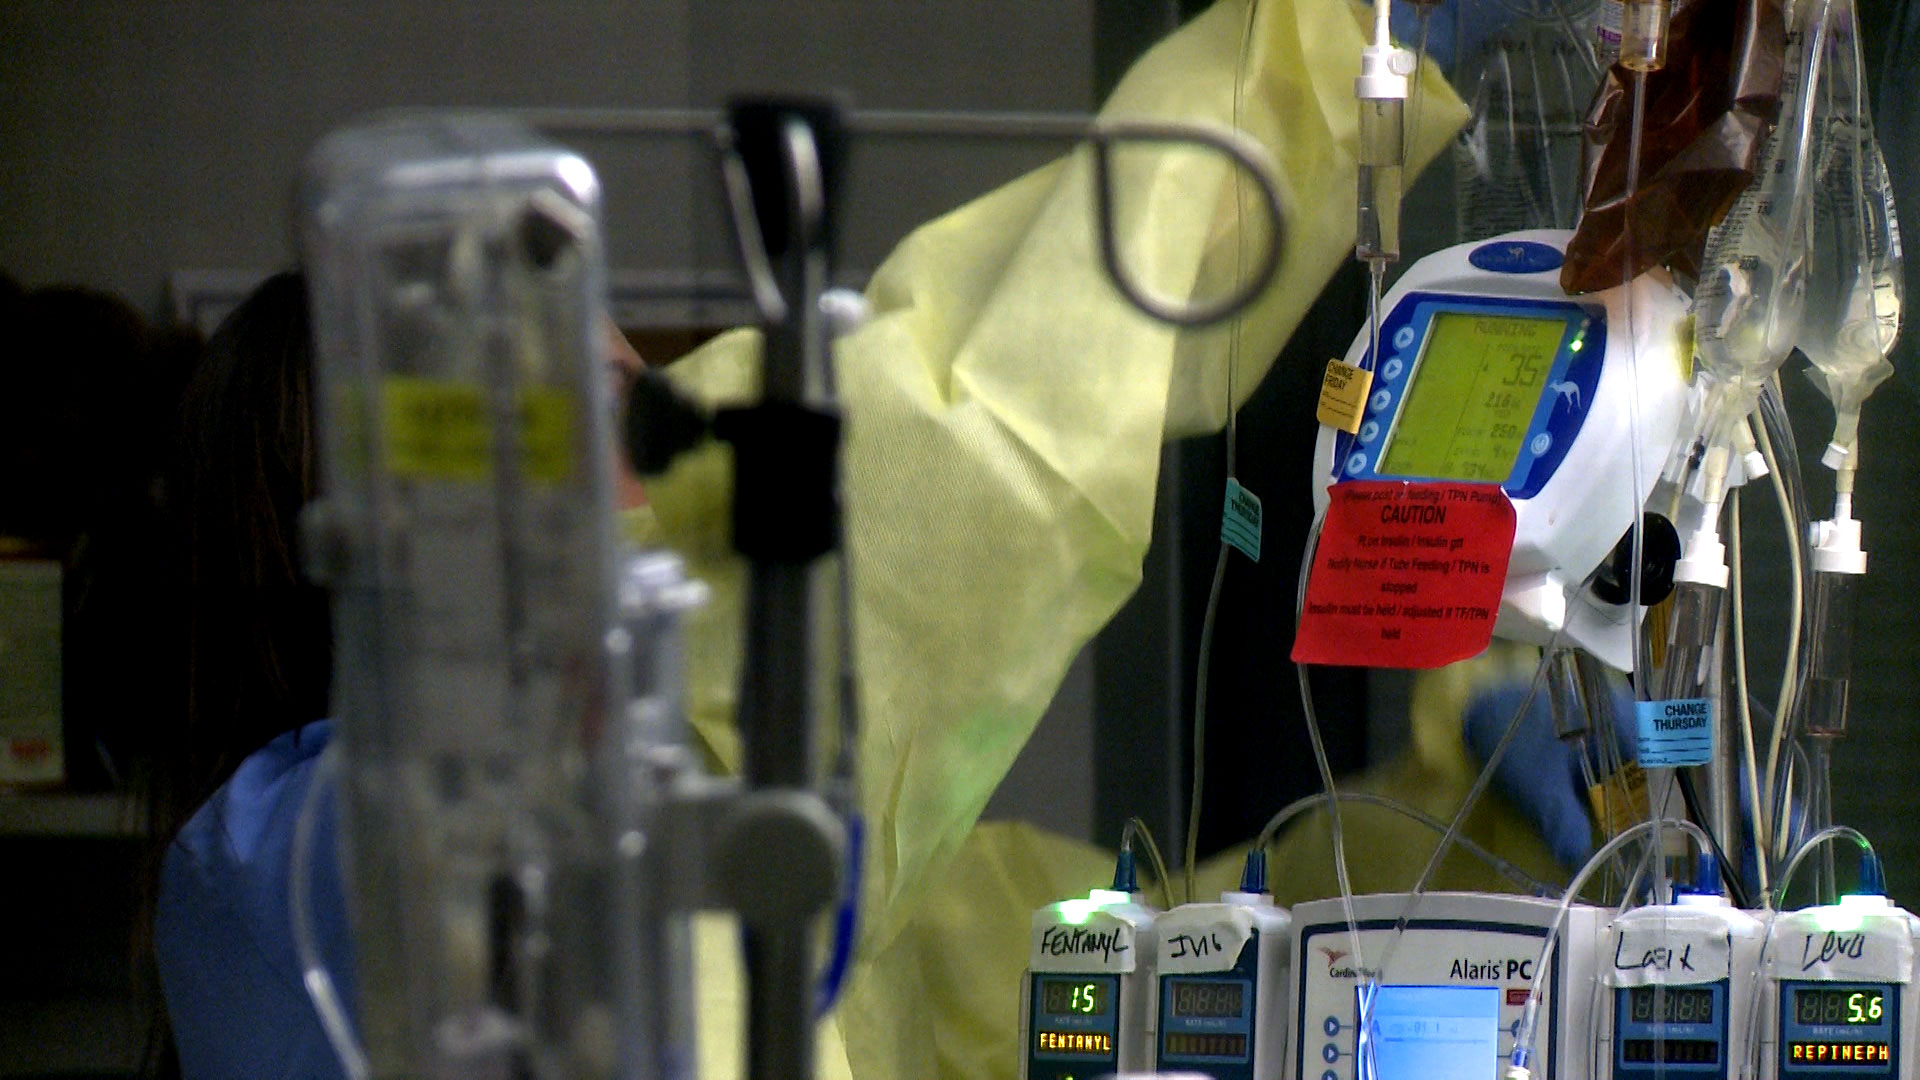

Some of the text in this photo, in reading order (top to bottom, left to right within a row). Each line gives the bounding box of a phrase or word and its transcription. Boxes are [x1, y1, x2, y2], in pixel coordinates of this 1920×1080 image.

[1502, 353, 1543, 387] 35
[1381, 504, 1447, 524] CAUTION
[1459, 560, 1479, 573] TPN
[1664, 703, 1707, 718] CHANGE
[1653, 717, 1708, 732] THURSDAY
[1041, 927, 1129, 963] FENTANYL
[1506, 960, 1532, 980] PC
[1071, 984, 1096, 1013] 15
[1848, 993, 1883, 1022] 5.6
[1040, 1033, 1111, 1051] FENTANYL
[1793, 1044, 1889, 1060] REPINEPH
